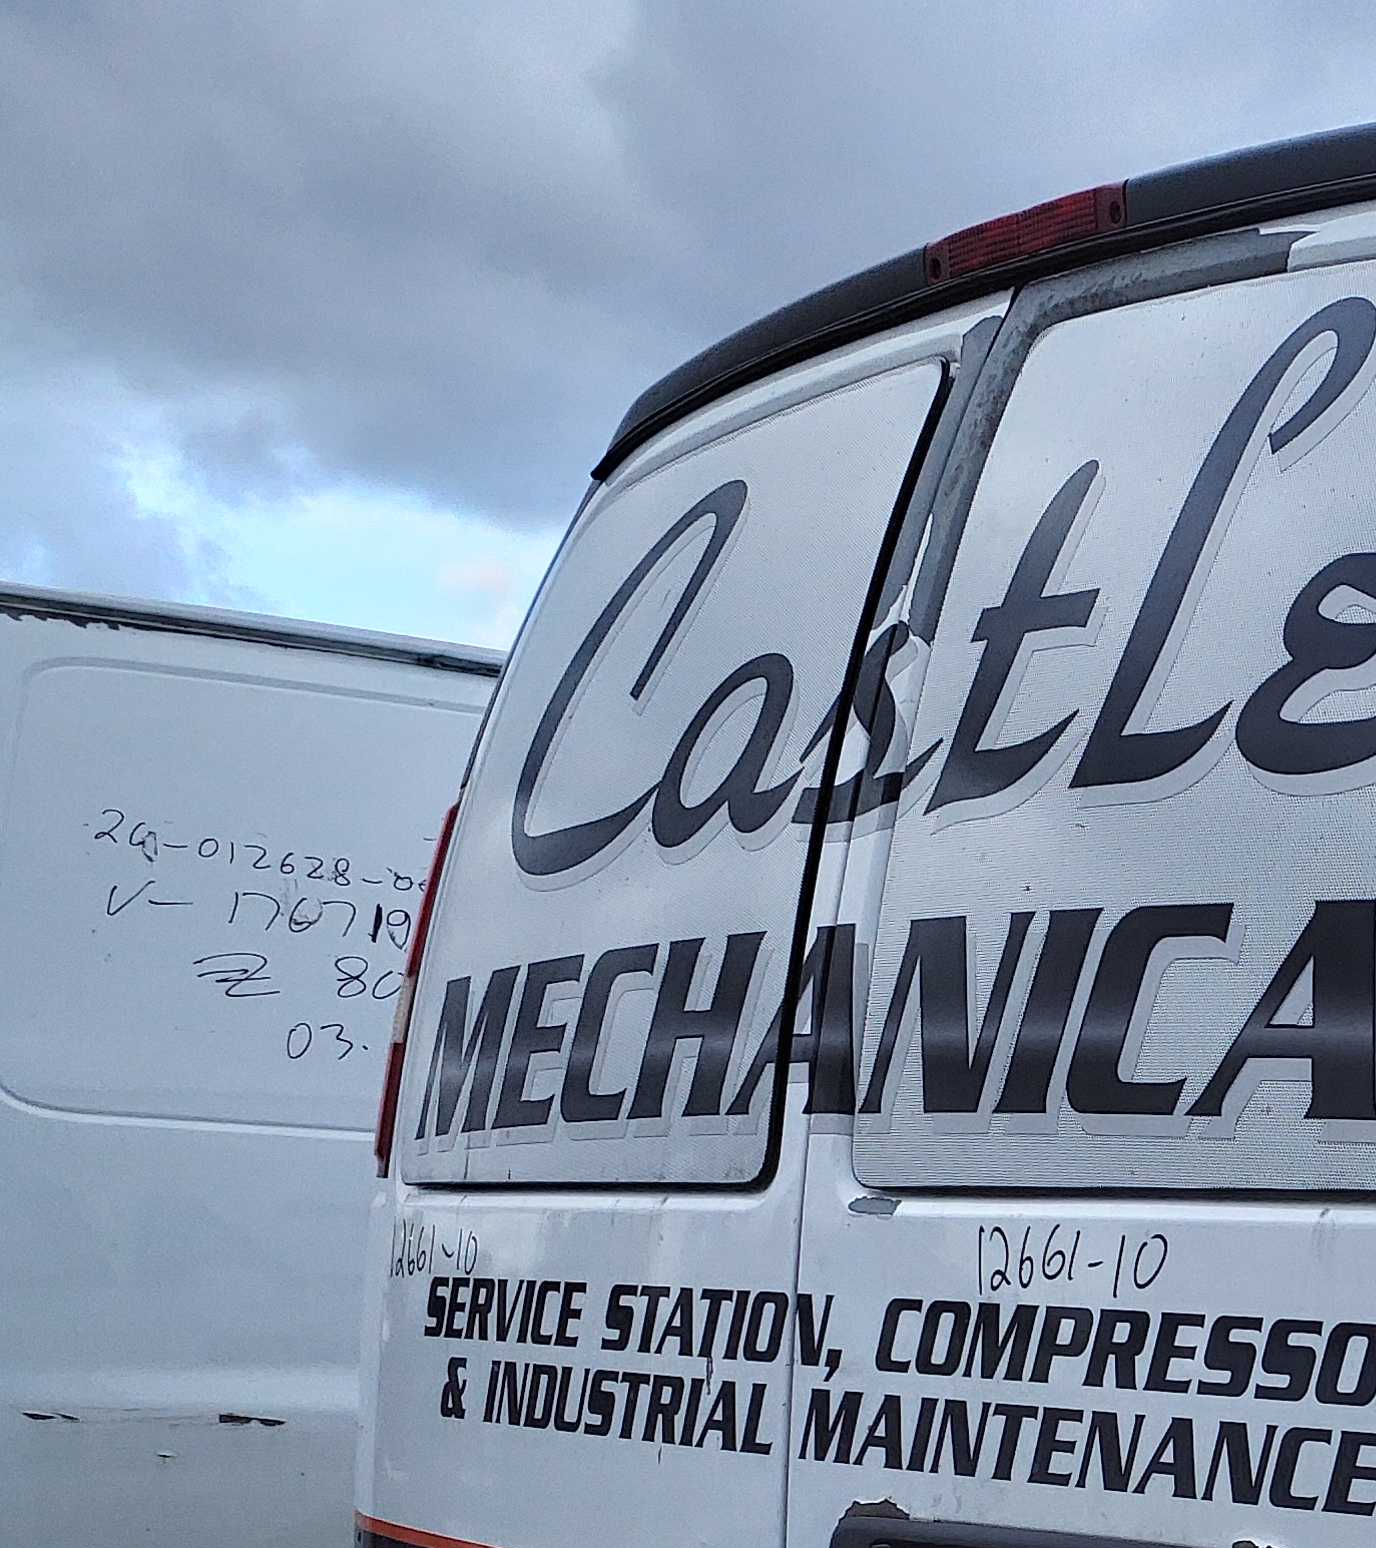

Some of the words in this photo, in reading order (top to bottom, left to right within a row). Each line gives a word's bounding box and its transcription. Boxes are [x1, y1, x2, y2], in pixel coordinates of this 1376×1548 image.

[978, 1224, 1168, 1297] 12661-10
[424, 1277, 587, 1347] SERVICE
[600, 1283, 842, 1382] STATION,
[441, 1357, 467, 1419] &
[483, 1360, 773, 1455] INDUSTRIAL
